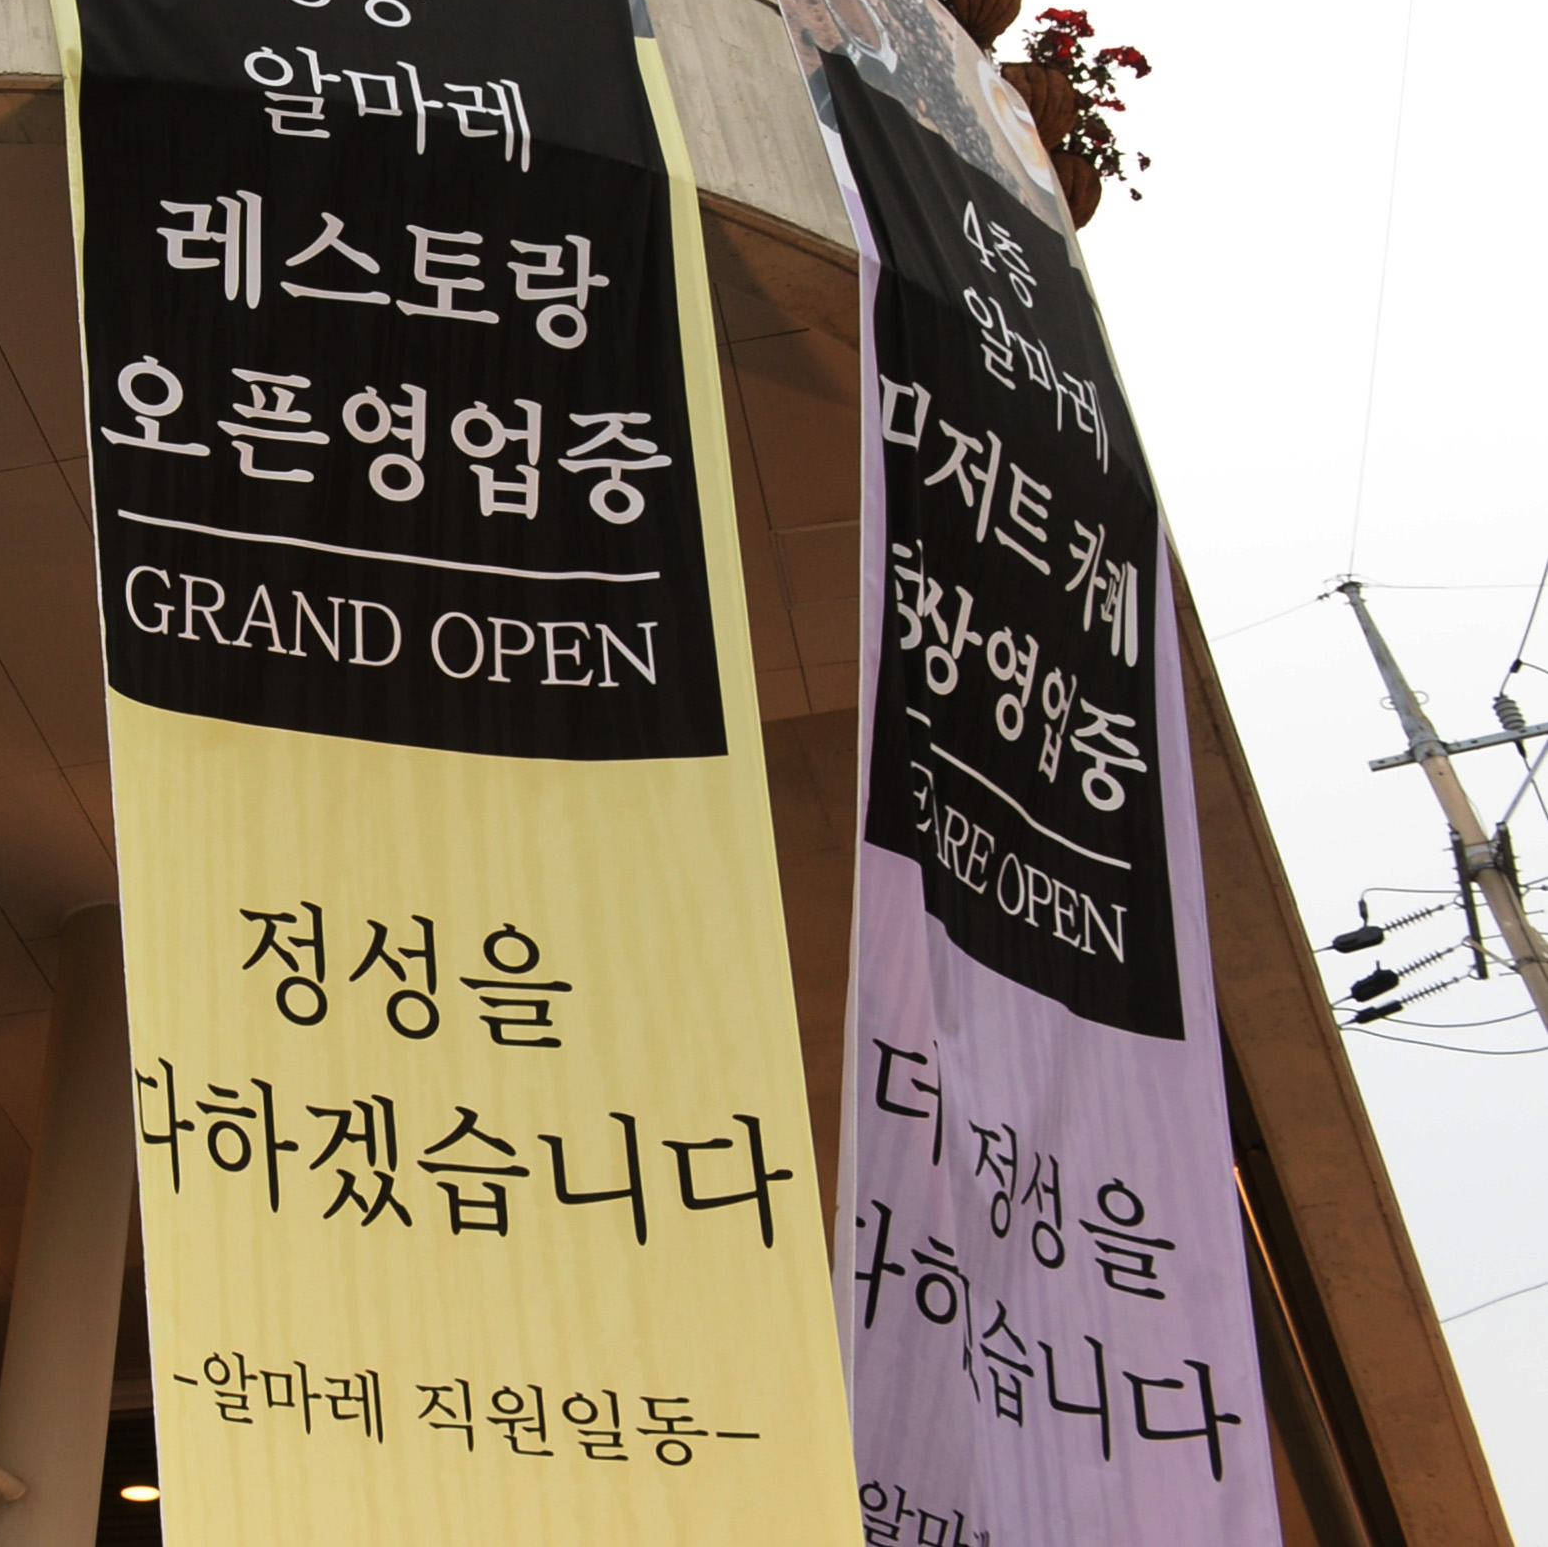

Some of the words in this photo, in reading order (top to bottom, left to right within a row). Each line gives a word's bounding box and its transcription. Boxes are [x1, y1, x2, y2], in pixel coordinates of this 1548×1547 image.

[242, 45, 532, 174] 알마레
[155, 188, 610, 350] 레스토랑
[963, 200, 1038, 309] 4층
[100, 354, 673, 526] 오픈영업중
[963, 286, 1109, 475] 알마레
[123, 564, 403, 668] GRAND
[429, 610, 659, 688] OPEN
[238, 900, 574, 1049] 정성을
[996, 852, 1128, 965] OPEN
[134, 1056, 794, 1249] 다하겠습니다
[871, 1037, 943, 1167] 더
[967, 1122, 1176, 1301] 정성을
[858, 1479, 991, 1547] 알마
